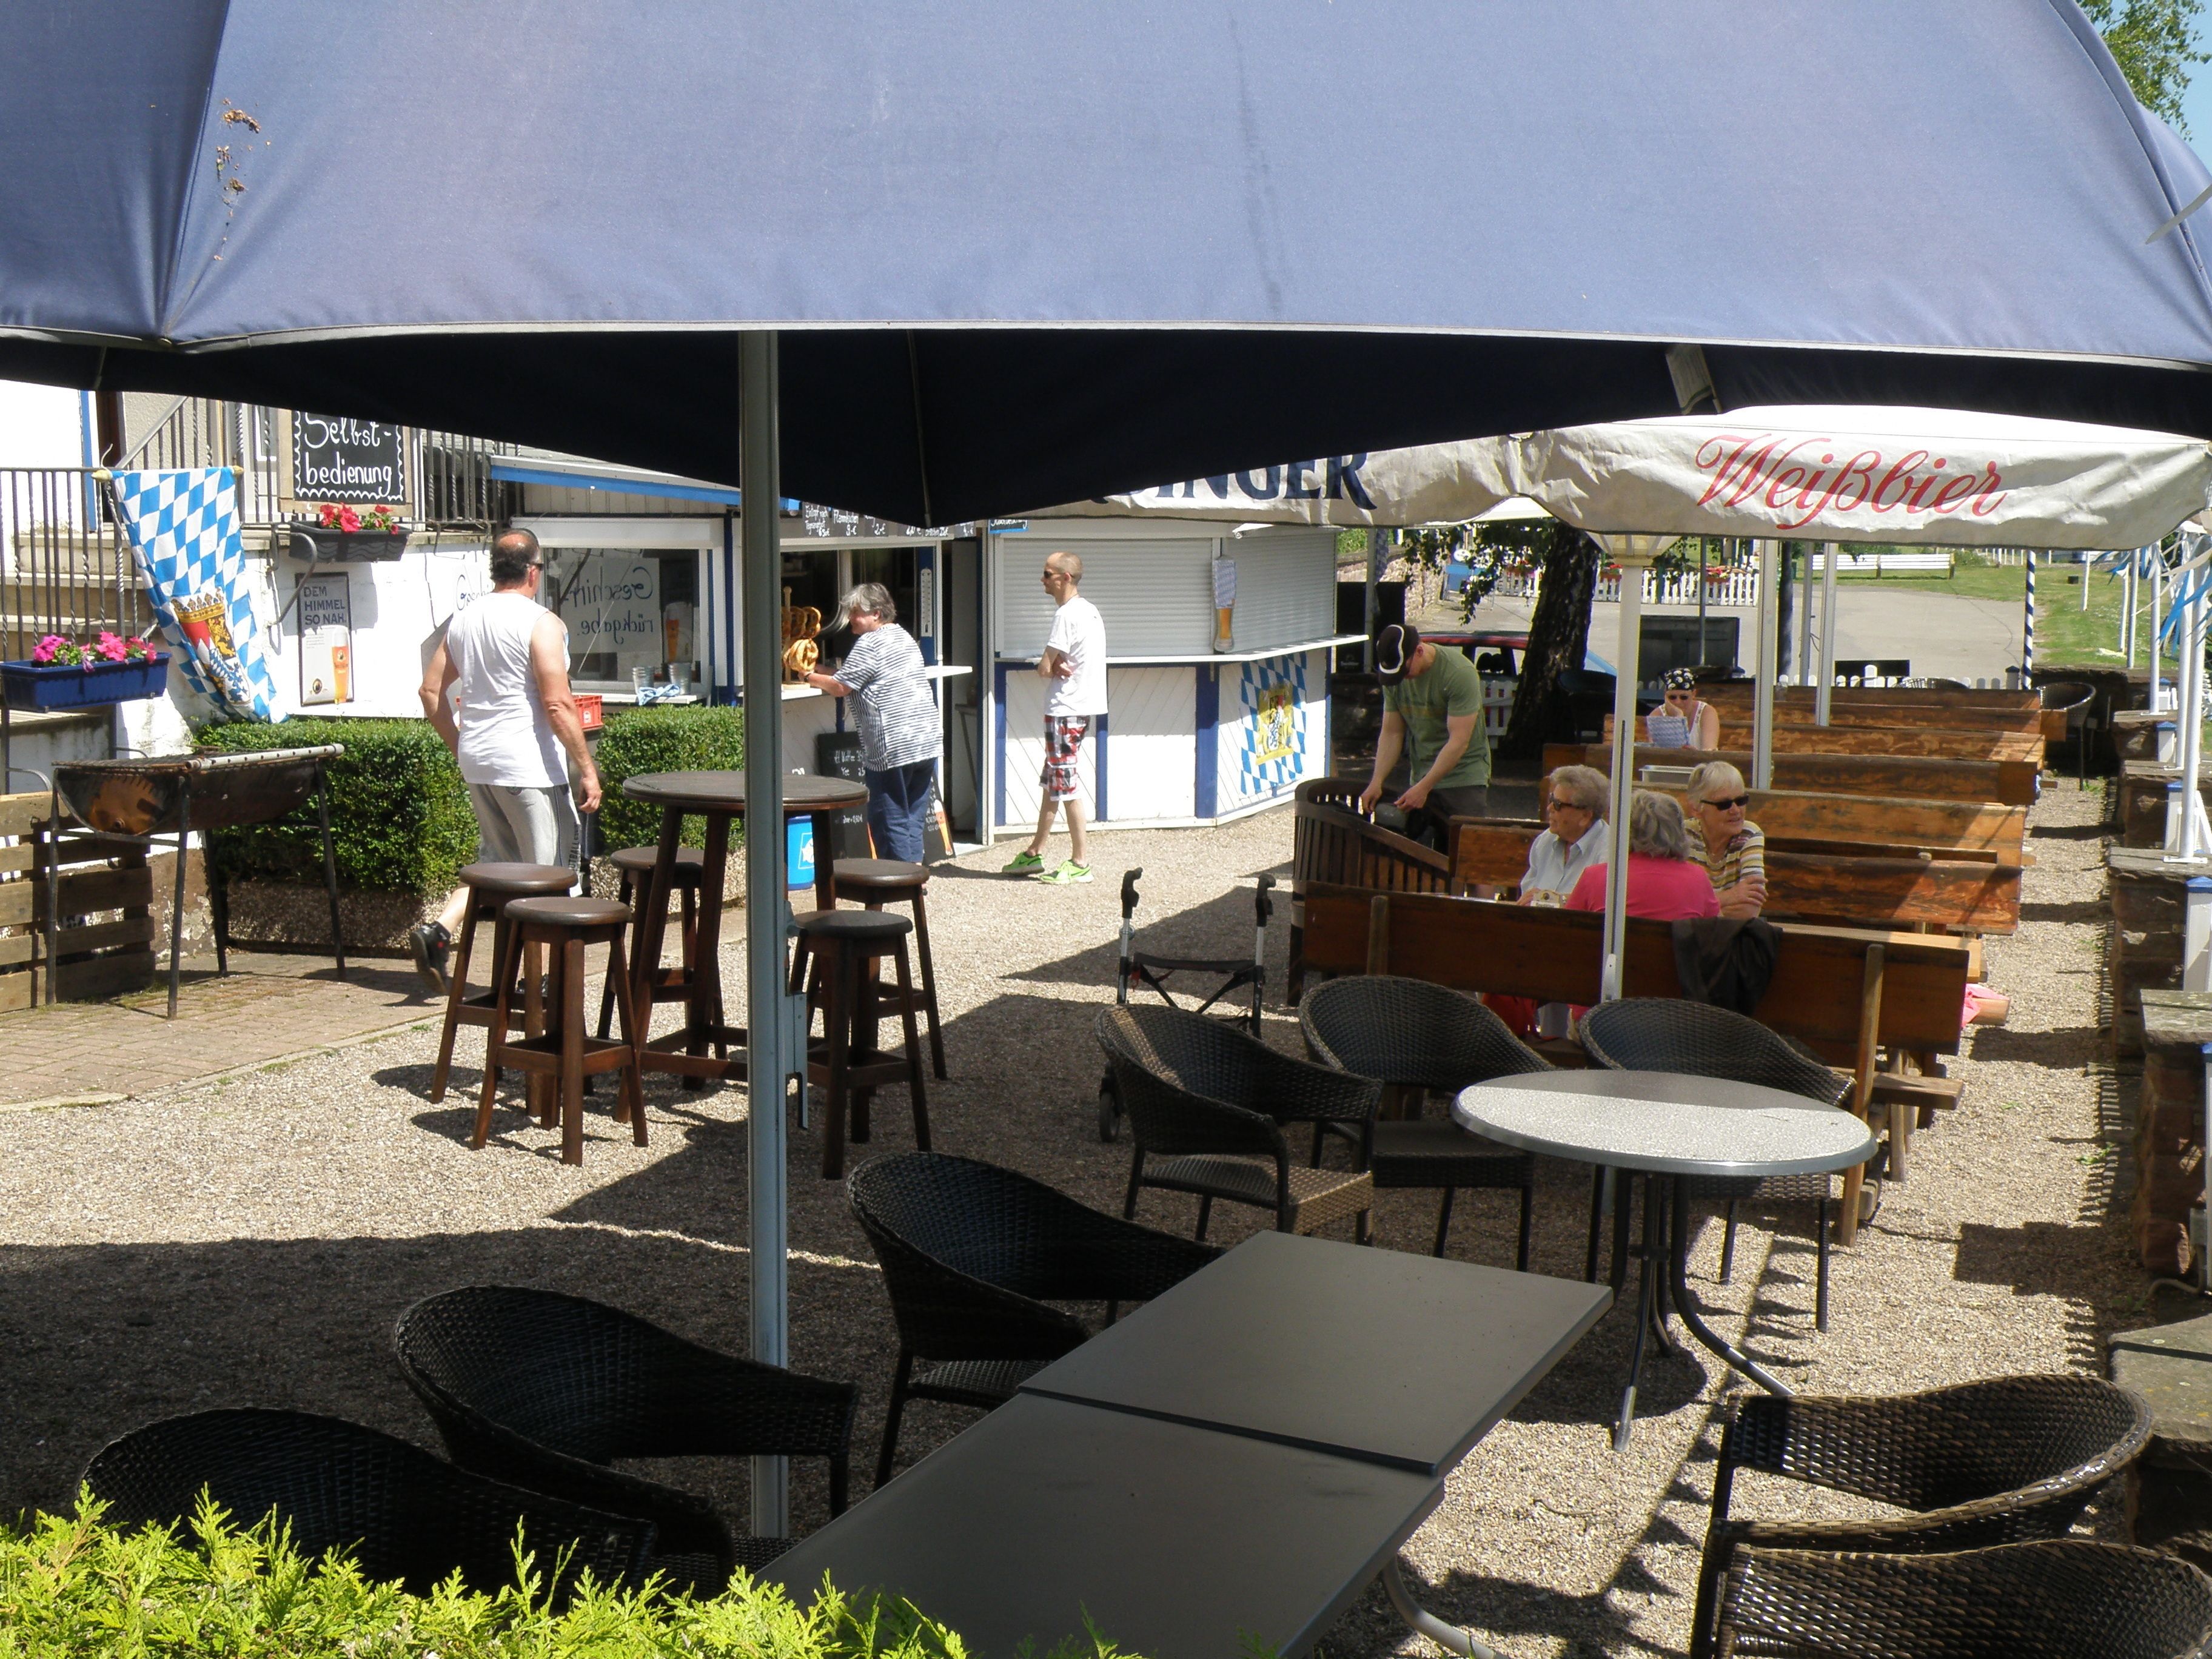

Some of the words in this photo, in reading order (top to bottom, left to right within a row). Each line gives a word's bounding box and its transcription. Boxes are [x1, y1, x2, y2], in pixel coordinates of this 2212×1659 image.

[304, 412, 392, 449] Selbst-
[305, 451, 392, 497] bedienung
[1695, 433, 2008, 530] Weißbier
[304, 586, 327, 597] DEM
[304, 599, 345, 611] HIMMEL
[304, 614, 320, 625] SO
[323, 613, 347, 625] NAH.
